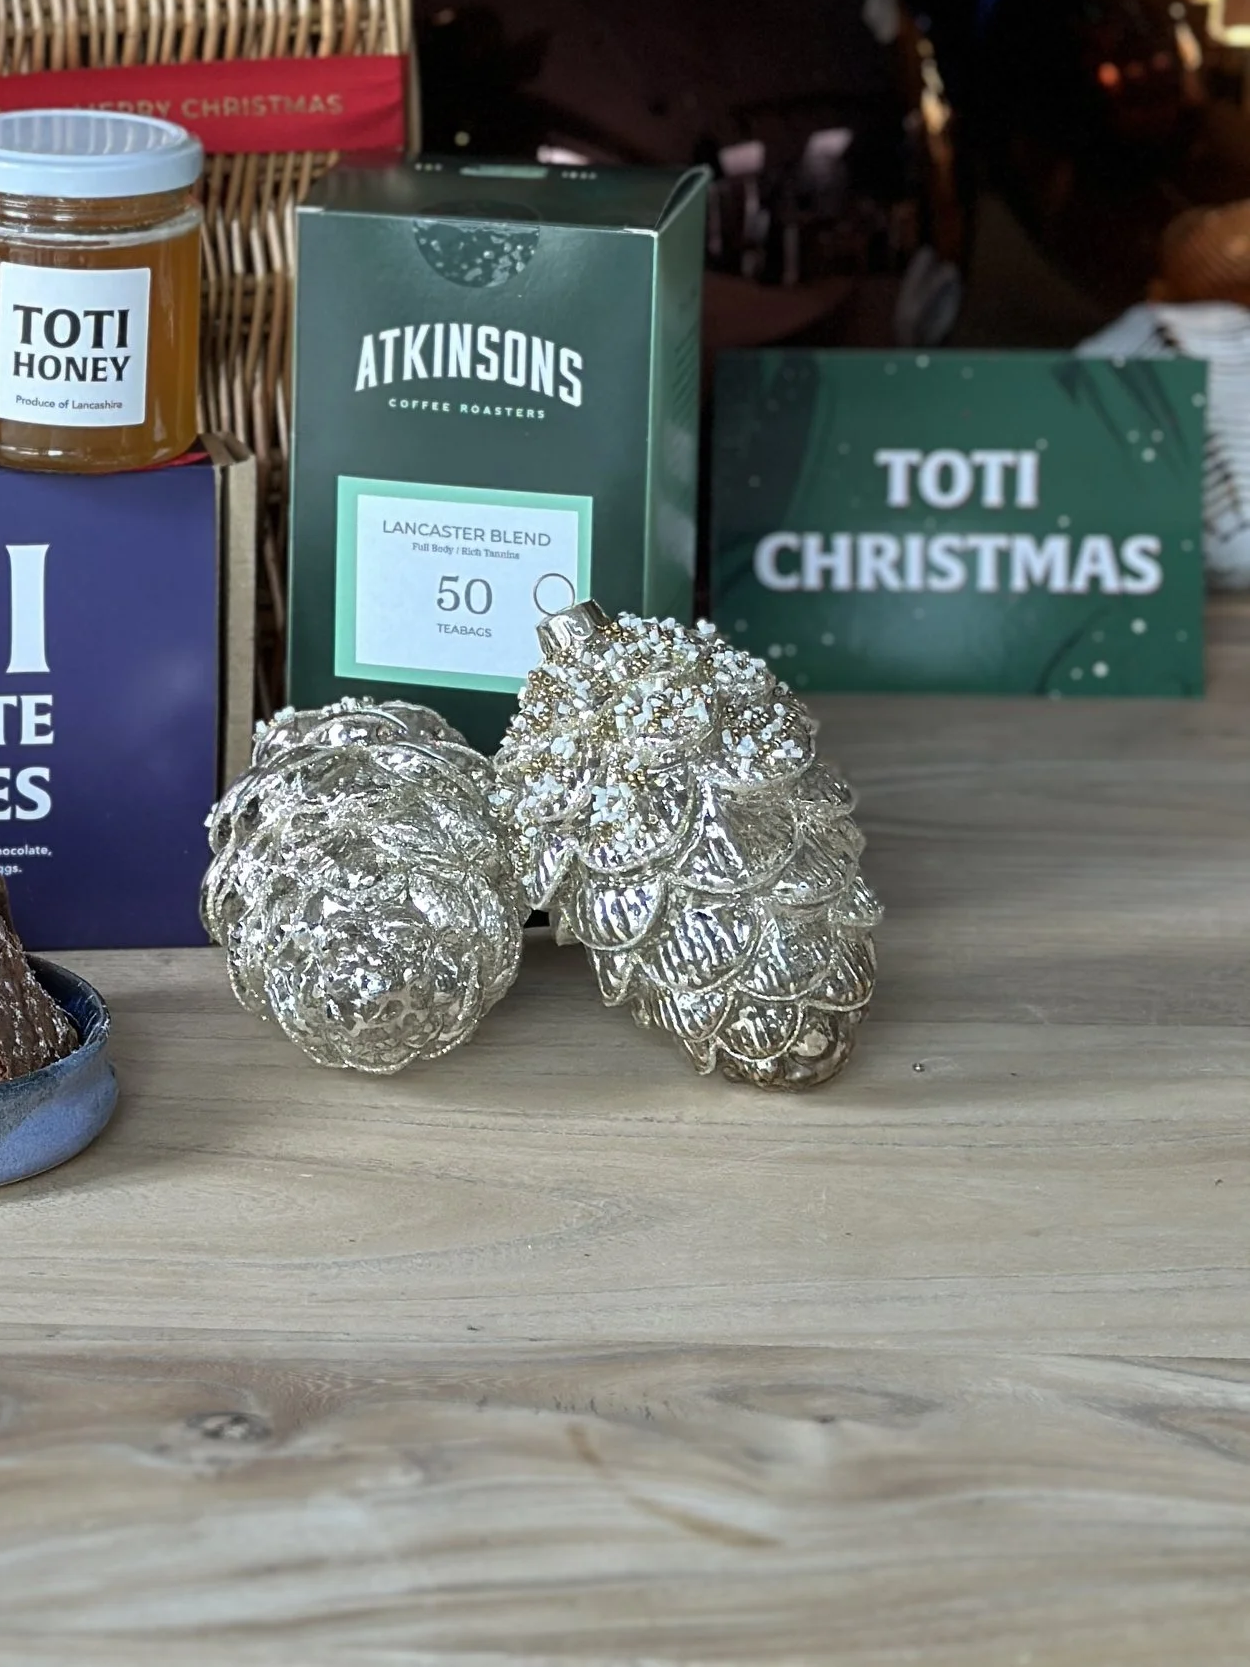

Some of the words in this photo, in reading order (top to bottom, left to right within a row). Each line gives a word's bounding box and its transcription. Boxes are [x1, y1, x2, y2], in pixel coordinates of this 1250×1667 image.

[181, 94, 344, 119] CHRISTMAS
[12, 304, 130, 349] TOTI
[12, 351, 131, 382] HONEY
[355, 322, 583, 408] ATKINSONS
[15, 395, 55, 408] Produce
[58, 400, 69, 409] of
[71, 400, 123, 410] Lancashire
[388, 398, 450, 412] COFFEE
[460, 403, 546, 419] ROASTERS
[874, 448, 1041, 510] TOTI
[382, 520, 485, 542] LANCASTER
[490, 529, 552, 547] BLEND
[412, 542, 429, 552] Full
[431, 543, 454, 556] Body
[461, 546, 482, 557] Rich
[483, 548, 520, 559] Tannins
[752, 531, 1164, 595] CHRISTMAS
[436, 575, 493, 615] 50
[436, 623, 492, 638] TEABAGS
